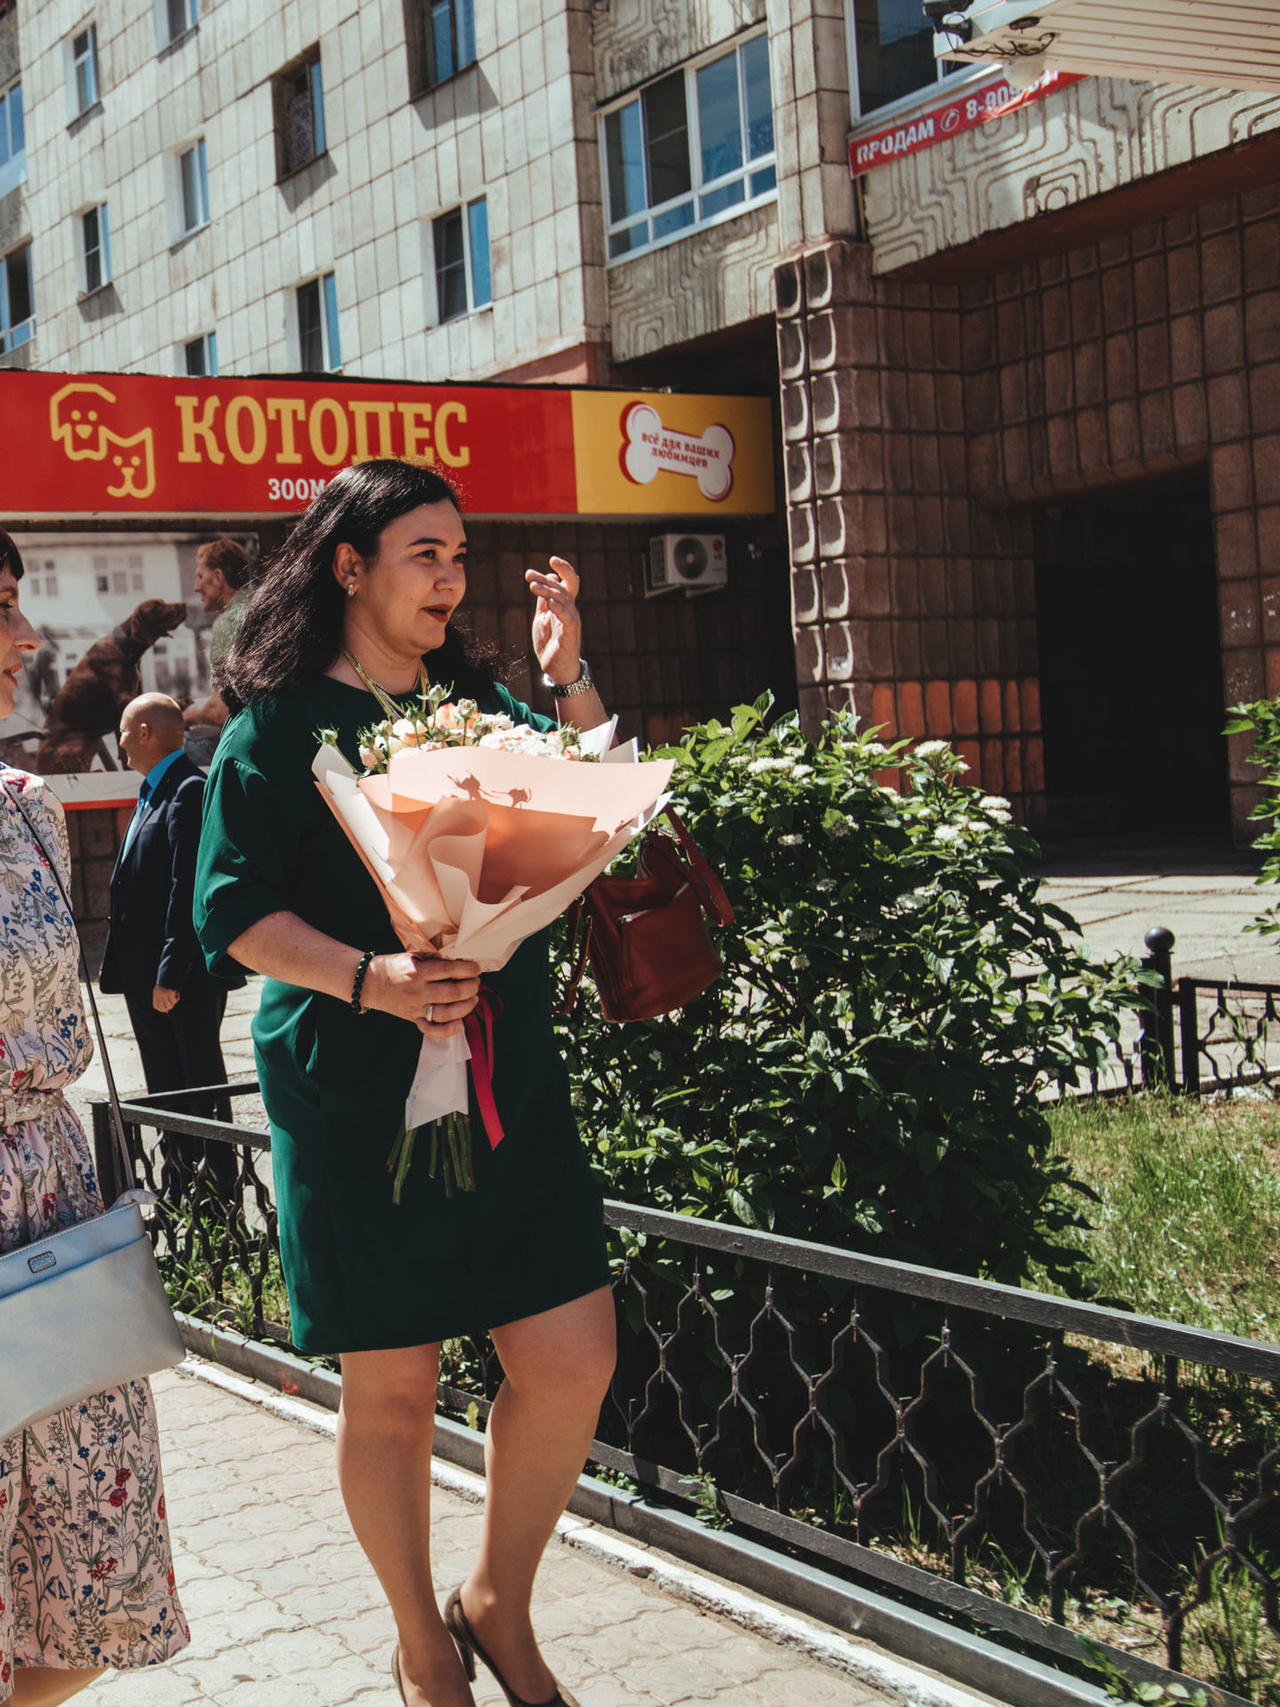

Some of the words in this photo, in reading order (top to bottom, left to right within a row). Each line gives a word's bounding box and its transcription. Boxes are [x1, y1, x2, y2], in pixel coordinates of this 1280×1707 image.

[857, 118, 934, 164] ПРОДАМ
[175, 395, 470, 468] КОТОПЕС
[641, 432, 659, 445] всё
[661, 437, 681, 451] для
[684, 442, 719, 460] ваших
[651, 447, 708, 468] любимцев
